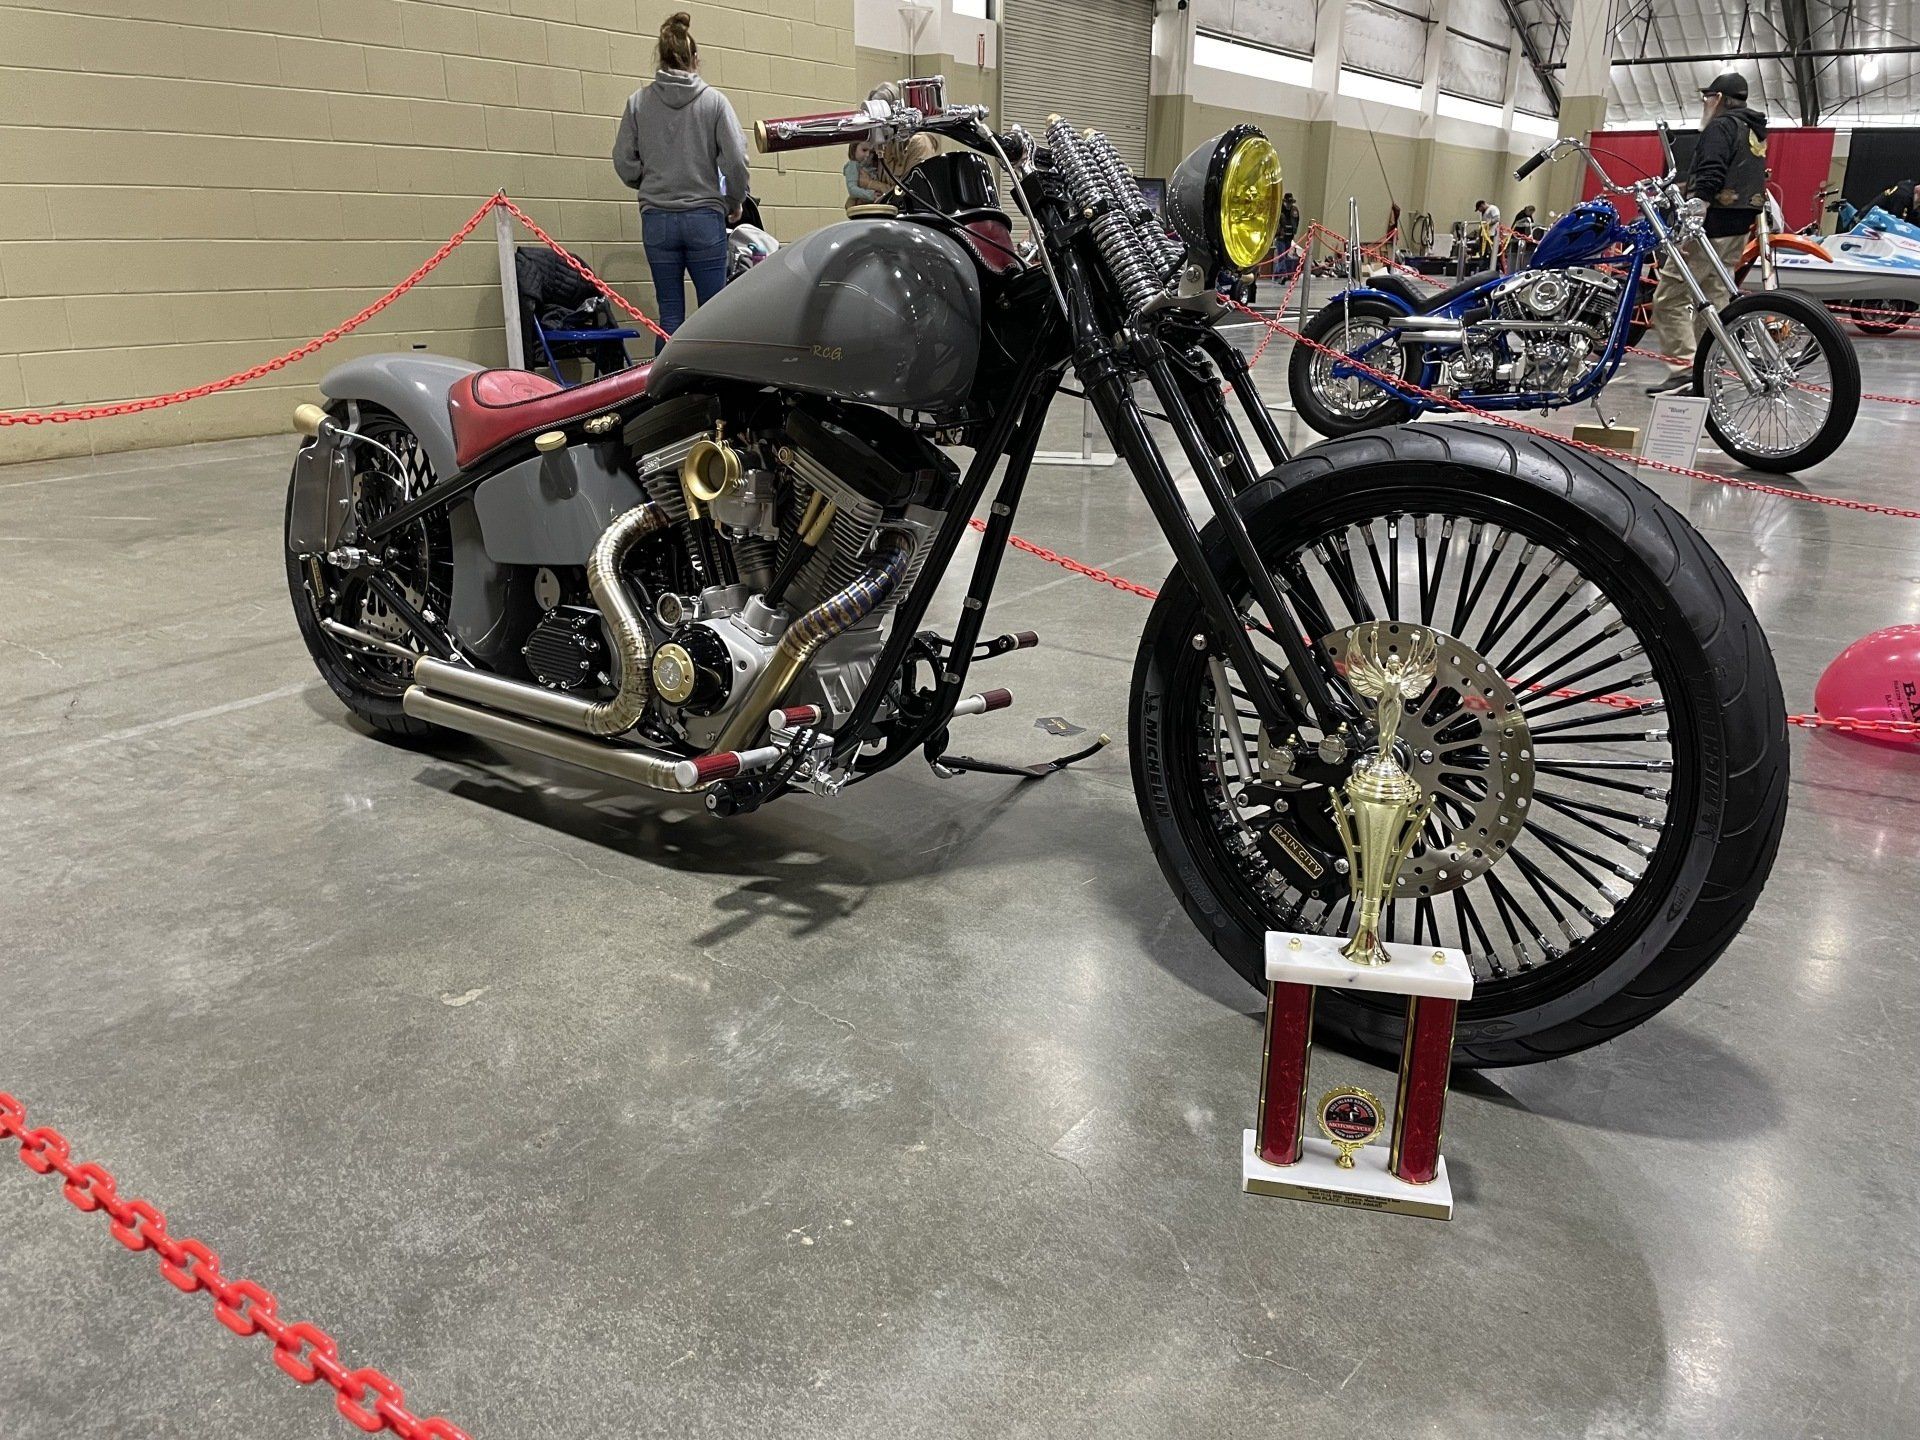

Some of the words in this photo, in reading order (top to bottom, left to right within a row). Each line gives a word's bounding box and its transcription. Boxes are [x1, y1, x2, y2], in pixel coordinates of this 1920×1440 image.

[1145, 717, 1171, 818] MICHELIN
[1273, 826, 1299, 850] RAIN
[1298, 850, 1322, 873] CITY
[1328, 1122, 1372, 1132] MOTORCYCLE
